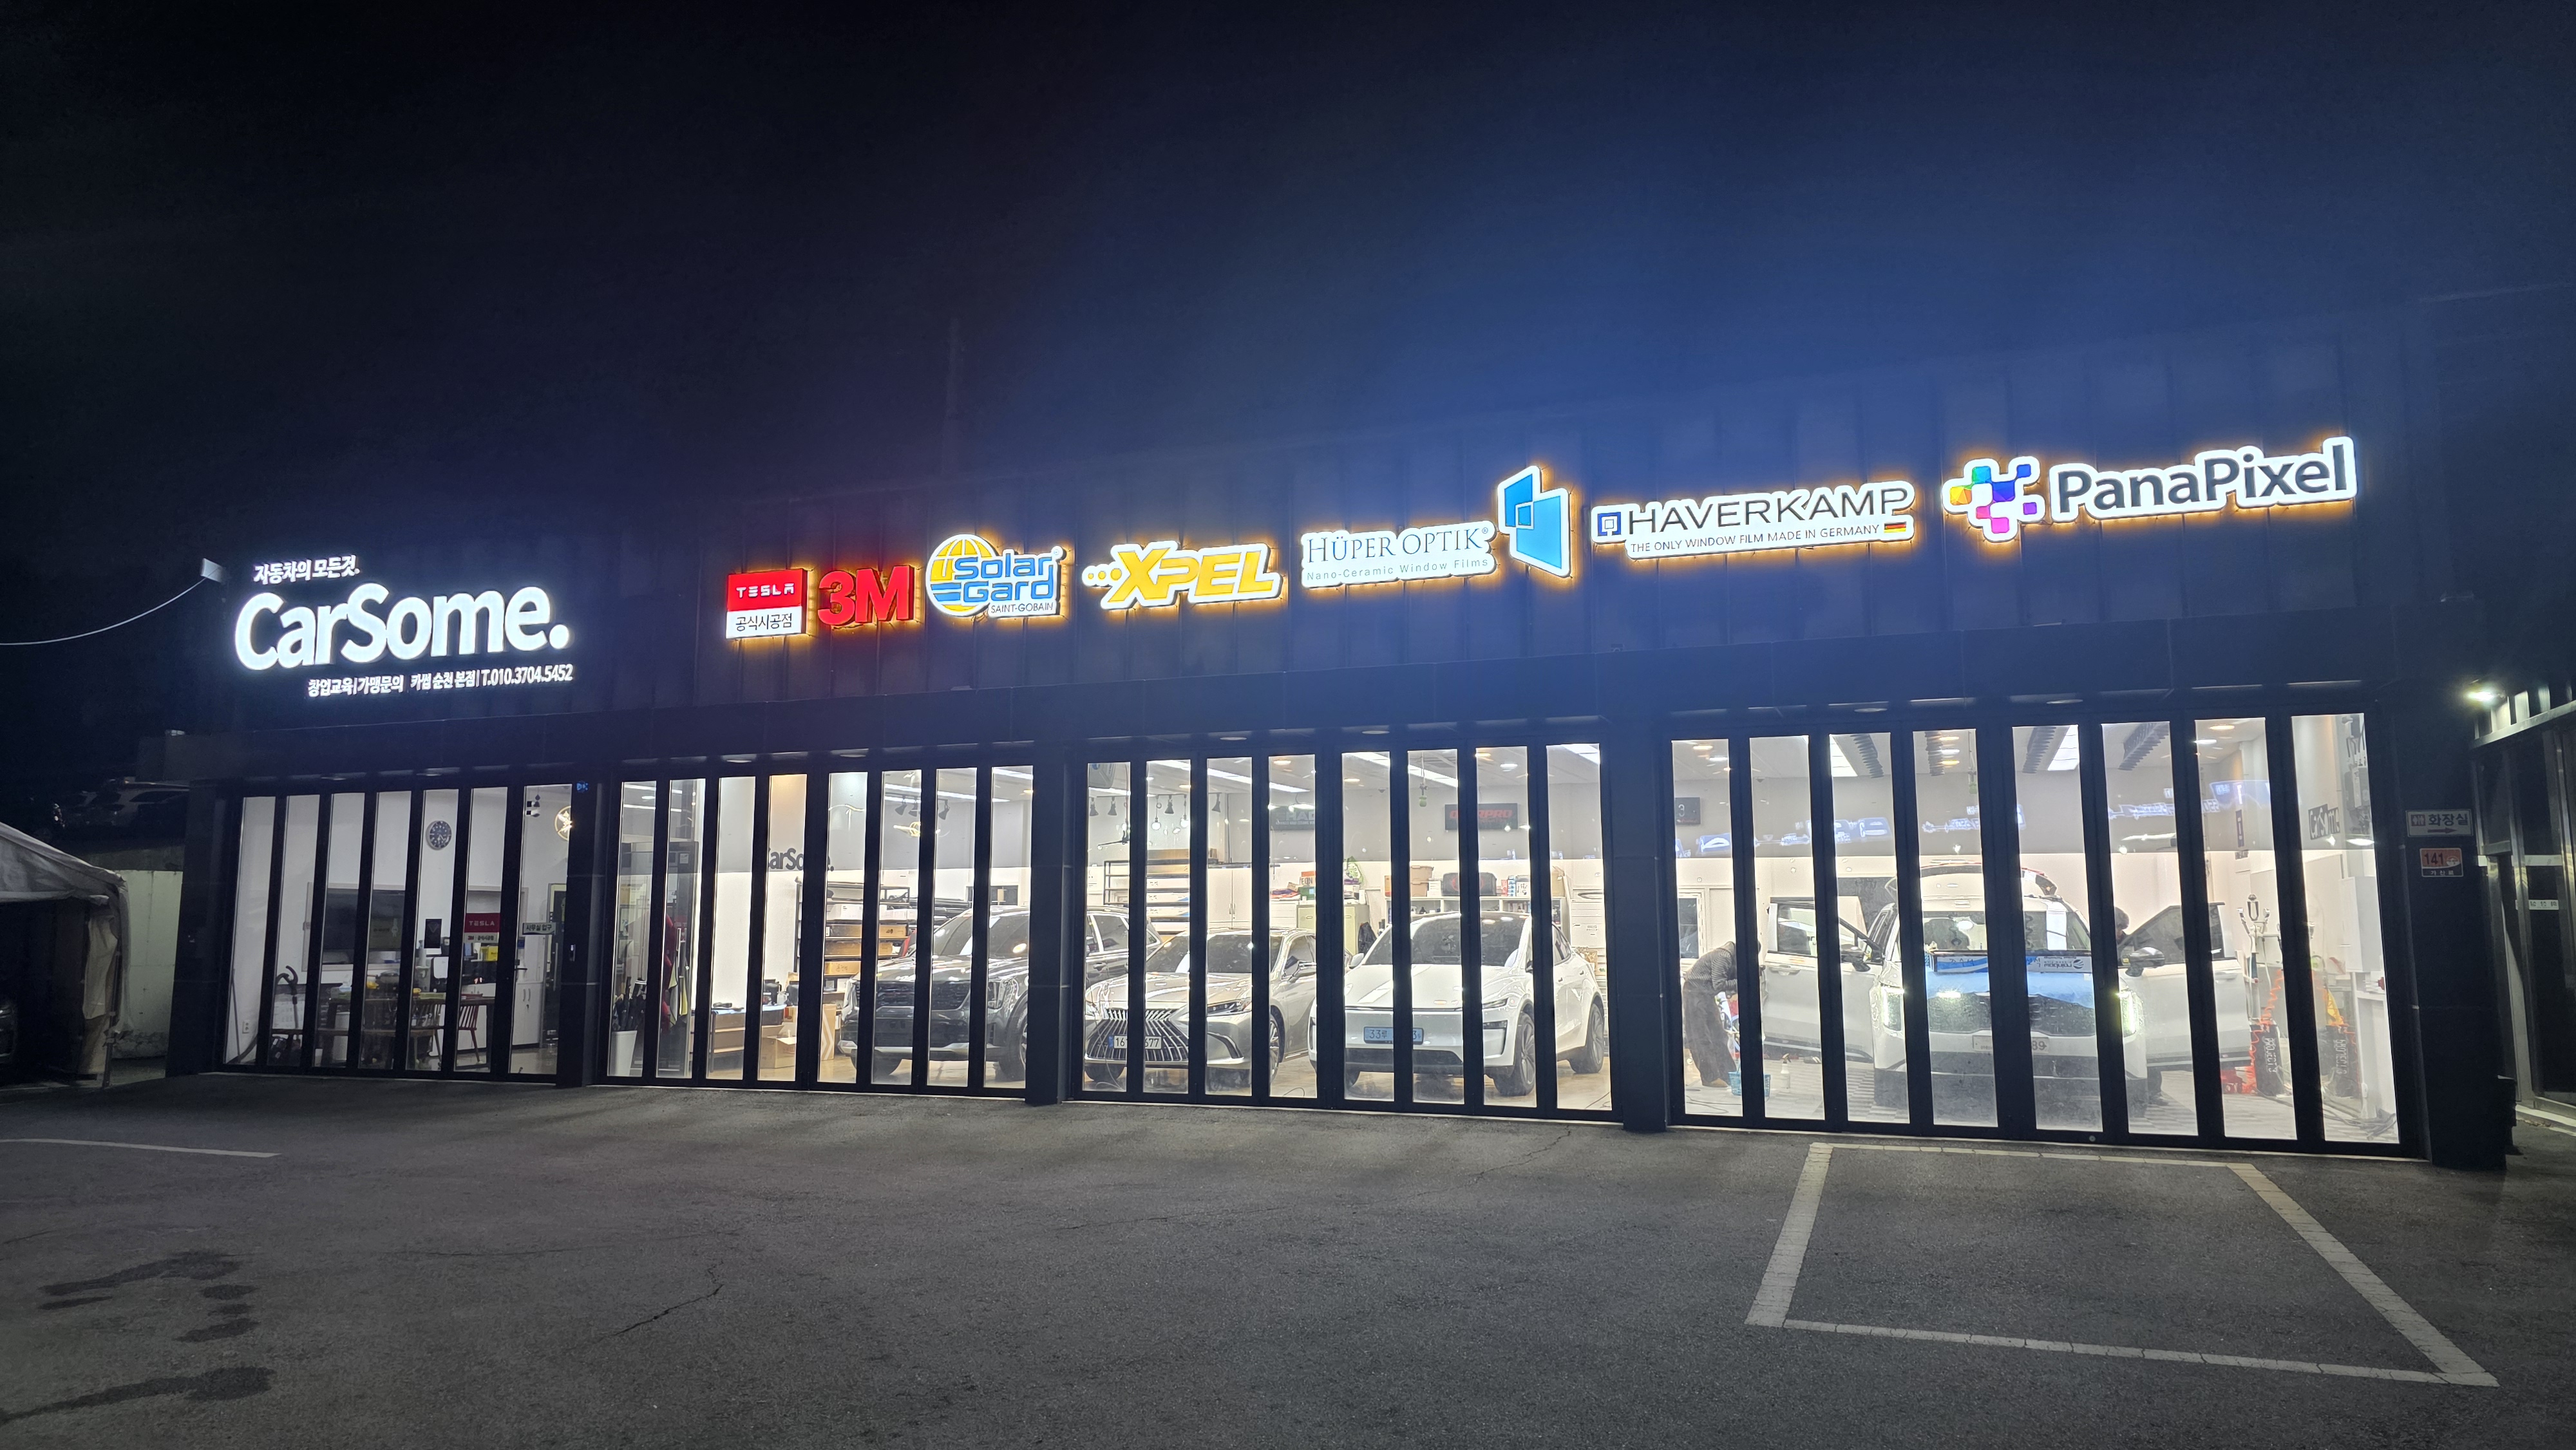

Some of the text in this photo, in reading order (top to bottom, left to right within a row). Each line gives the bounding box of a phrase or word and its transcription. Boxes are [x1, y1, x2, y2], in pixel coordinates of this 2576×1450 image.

[2060, 444, 2345, 513] PanaPixel
[1629, 488, 1908, 534] HAVERKAMP
[1307, 528, 1482, 563] HÜPER OPTIK
[1631, 524, 1879, 552] THE ONLY WINDOW FILM MADE IN GERMANY
[253, 554, 360, 585] 자동차의 모든것.
[954, 553, 1052, 579] Solar
[1107, 547, 1274, 602] XPEL
[1307, 558, 1488, 581] Nano-Ceramic Window Films
[736, 583, 795, 598] TESLA
[818, 565, 911, 626] 3M
[963, 565, 1054, 602] Gard
[990, 602, 1054, 614] SAINT-GOBAIN
[234, 583, 570, 671] CarSome.
[735, 612, 793, 632] 공식시공점
[432, 672, 453, 689] 순천
[2428, 814, 2468, 826] 화장실
[768, 848, 835, 872] arSo.
[2425, 852, 2444, 865] 141
[1115, 1037, 1159, 1048] 16 677
[1369, 1030, 1388, 1039] 33루
[2264, 1037, 2277, 1066] PROJECT
